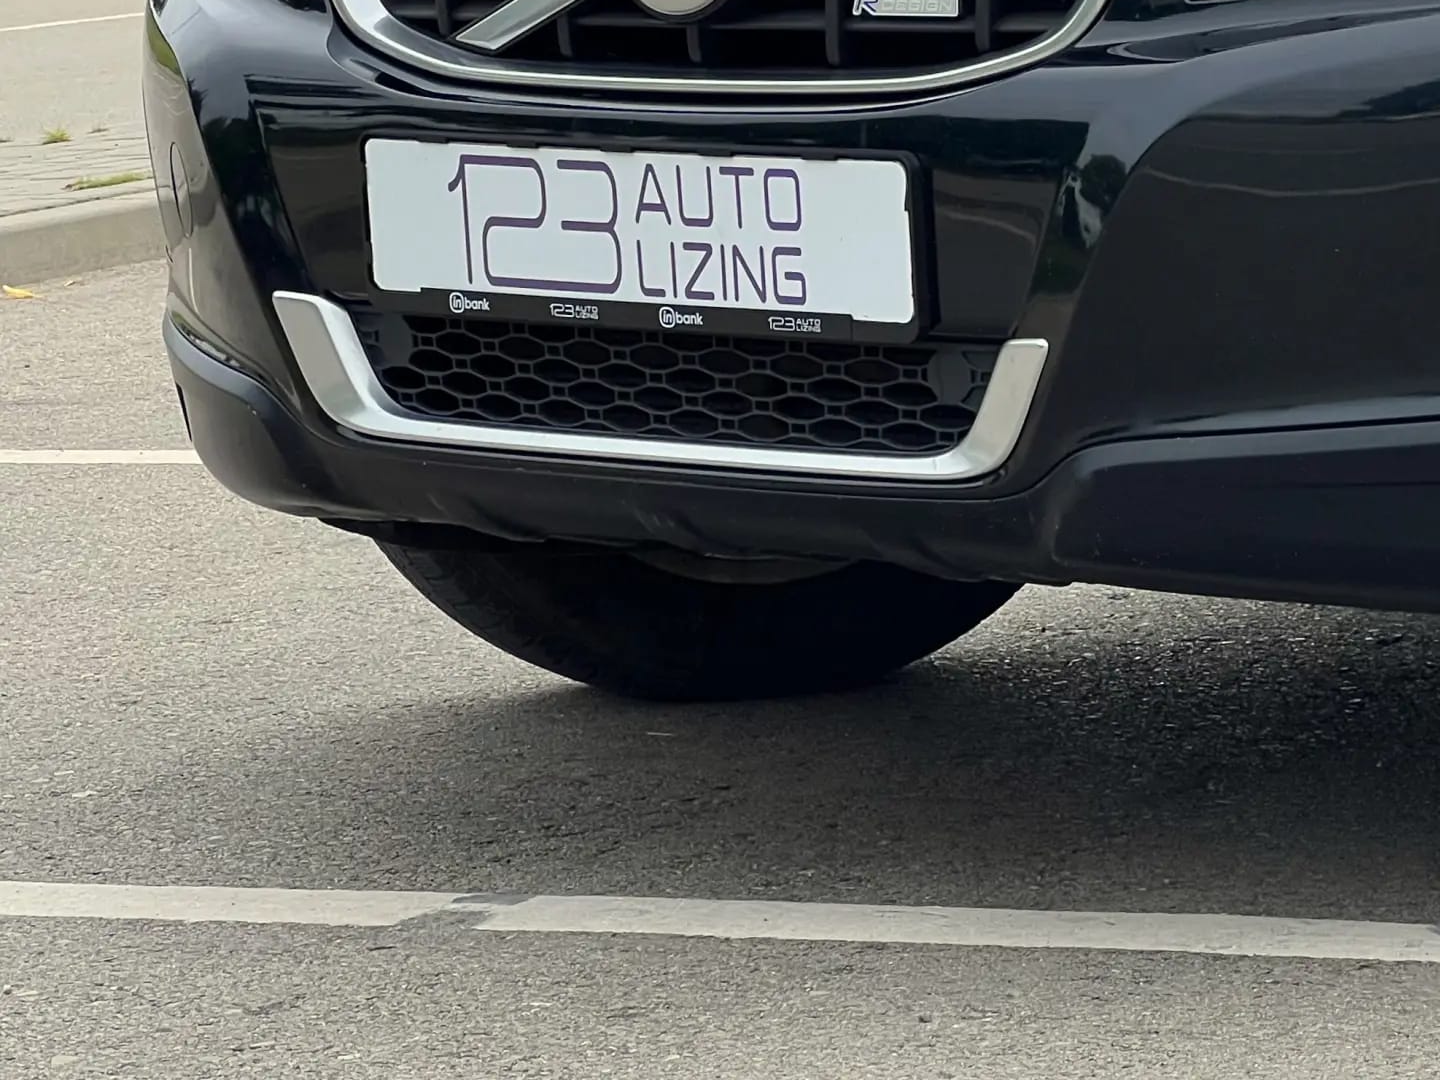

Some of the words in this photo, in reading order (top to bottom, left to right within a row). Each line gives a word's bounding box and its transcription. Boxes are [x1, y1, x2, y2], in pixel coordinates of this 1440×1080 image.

[635, 163, 802, 232] AUTO
[448, 154, 622, 294] 123
[637, 239, 807, 306] LIZING
[550, 303, 574, 318] 123
[575, 305, 598, 313] AUTO
[768, 316, 795, 331] 123
[796, 318, 821, 326] AUTO
